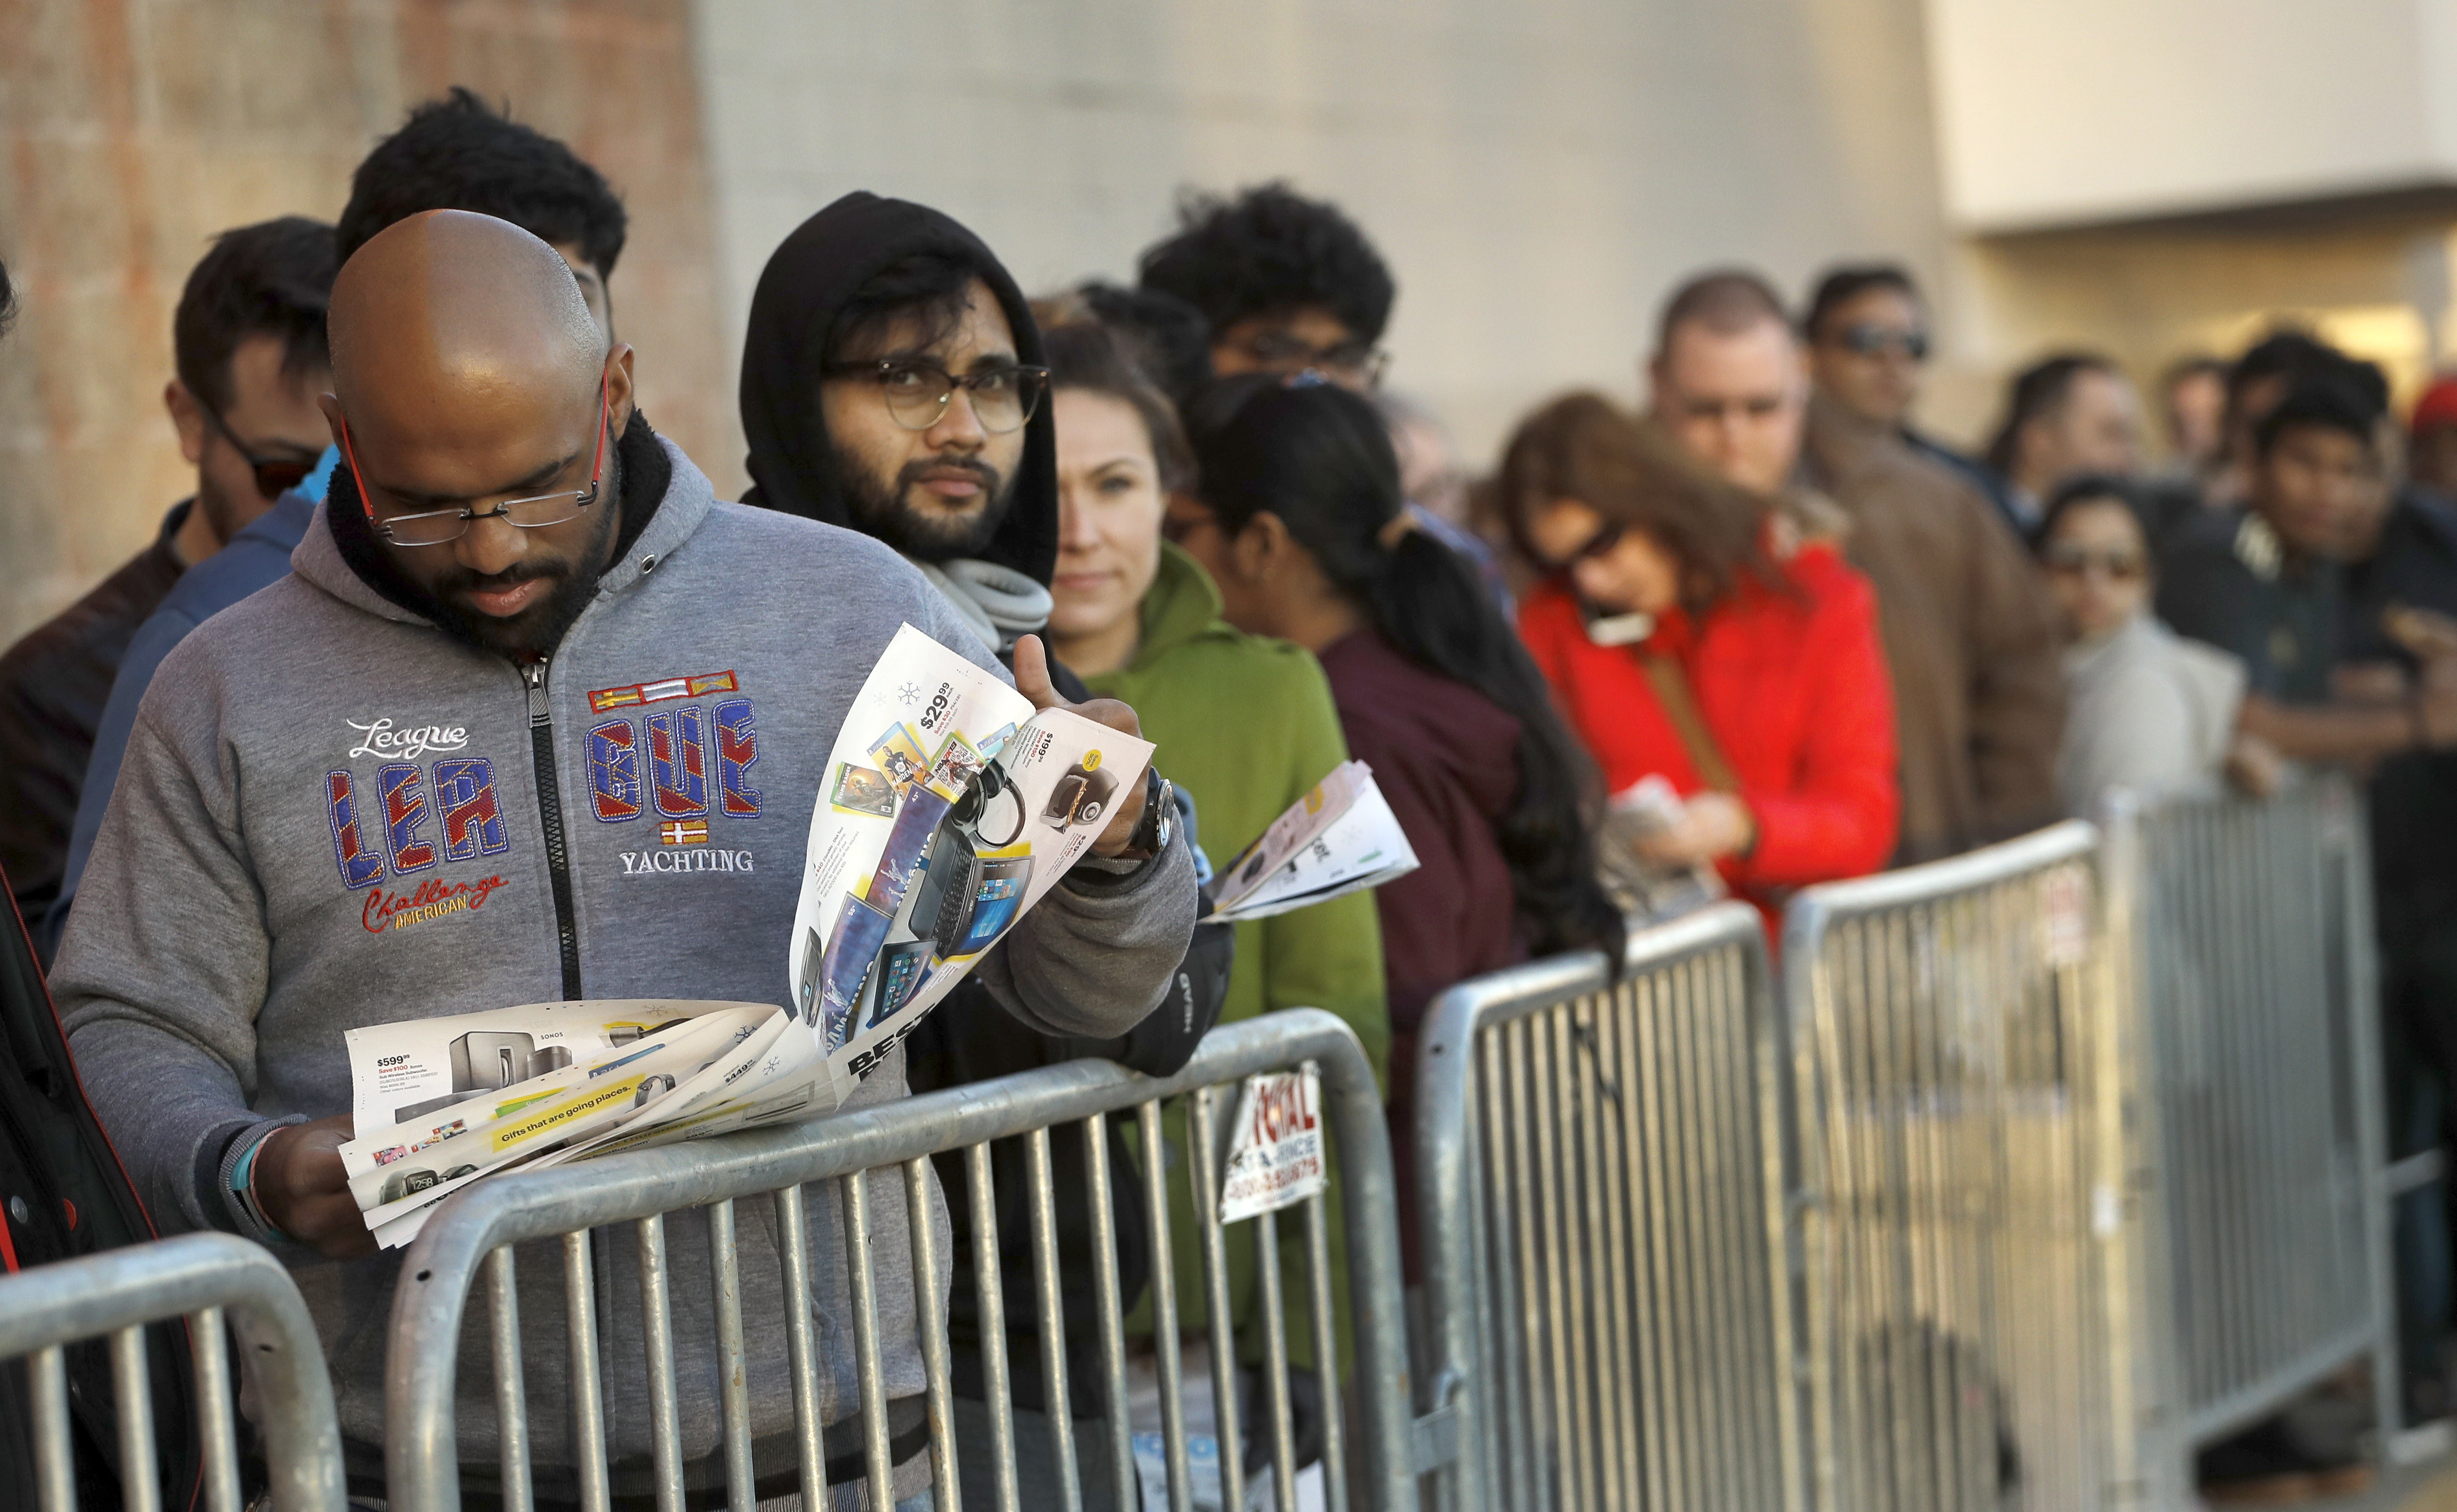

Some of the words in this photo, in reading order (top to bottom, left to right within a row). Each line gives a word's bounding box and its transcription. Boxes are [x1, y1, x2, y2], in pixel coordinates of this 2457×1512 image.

[934, 722, 944, 734] Save
[942, 711, 950, 721] $30
[1037, 730, 1045, 744] Save
[346, 717, 469, 760] League
[1031, 744, 1039, 757] $150
[837, 784, 845, 799] TOMB
[843, 766, 851, 784] RAIDER
[891, 770, 913, 788] MADDEN
[325, 757, 510, 890] LEA
[619, 849, 754, 874] YACHTING
[362, 874, 511, 934] Challenge
[394, 894, 469, 931] AMERICAN
[540, 1031, 563, 1040] SONOS
[501, 1127, 526, 1142] Gifts
[527, 1118, 547, 1133] that
[548, 1111, 565, 1124] are
[566, 1099, 594, 1117] going
[595, 1085, 632, 1107] places.
